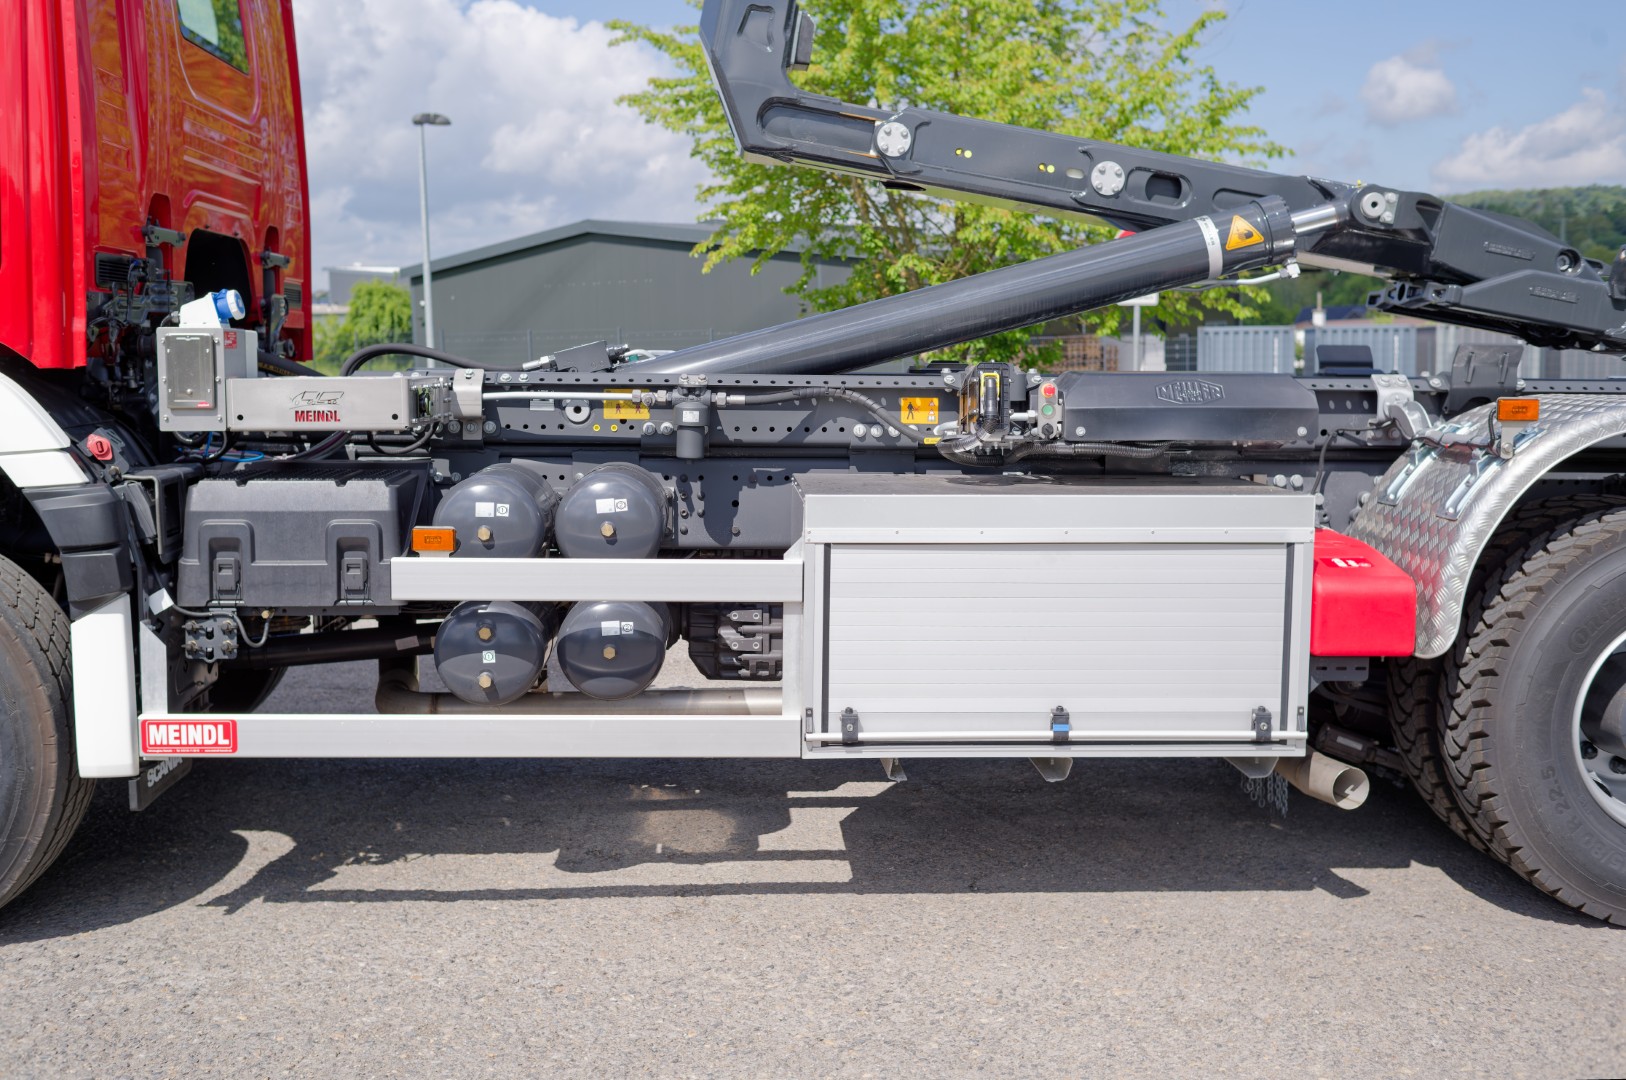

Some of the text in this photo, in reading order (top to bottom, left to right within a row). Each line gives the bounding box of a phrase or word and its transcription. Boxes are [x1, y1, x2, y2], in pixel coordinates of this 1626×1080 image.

[294, 409, 341, 423] MEINDL
[149, 724, 229, 745] MEINDL
[1540, 766, 1571, 815] 22.5
